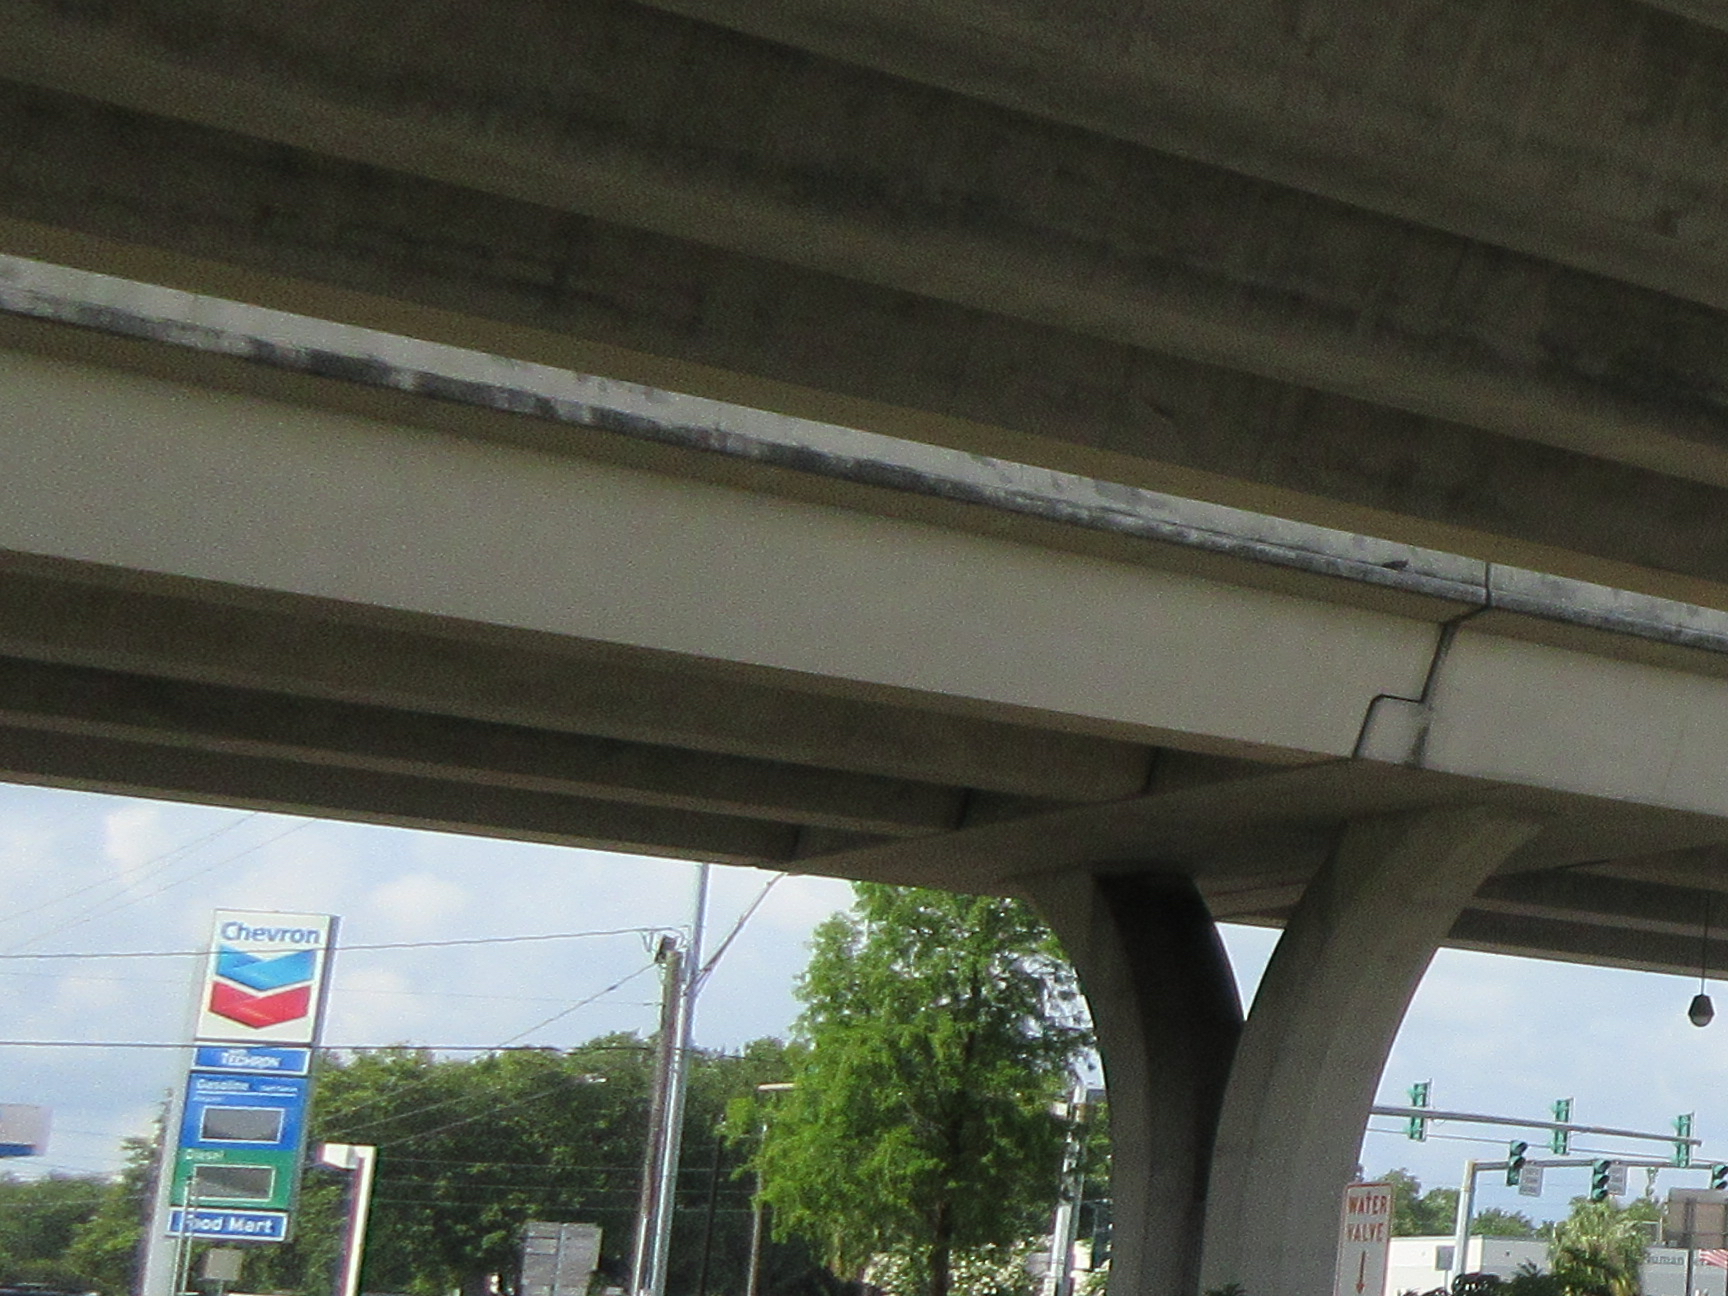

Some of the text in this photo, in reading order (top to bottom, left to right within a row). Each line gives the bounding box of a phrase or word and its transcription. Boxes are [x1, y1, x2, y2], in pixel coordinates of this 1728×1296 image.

[221, 921, 321, 944] Chevron
[1349, 1195, 1387, 1214] WATER
[229, 1217, 273, 1233] Mart
[1347, 1223, 1383, 1242] VALVE
